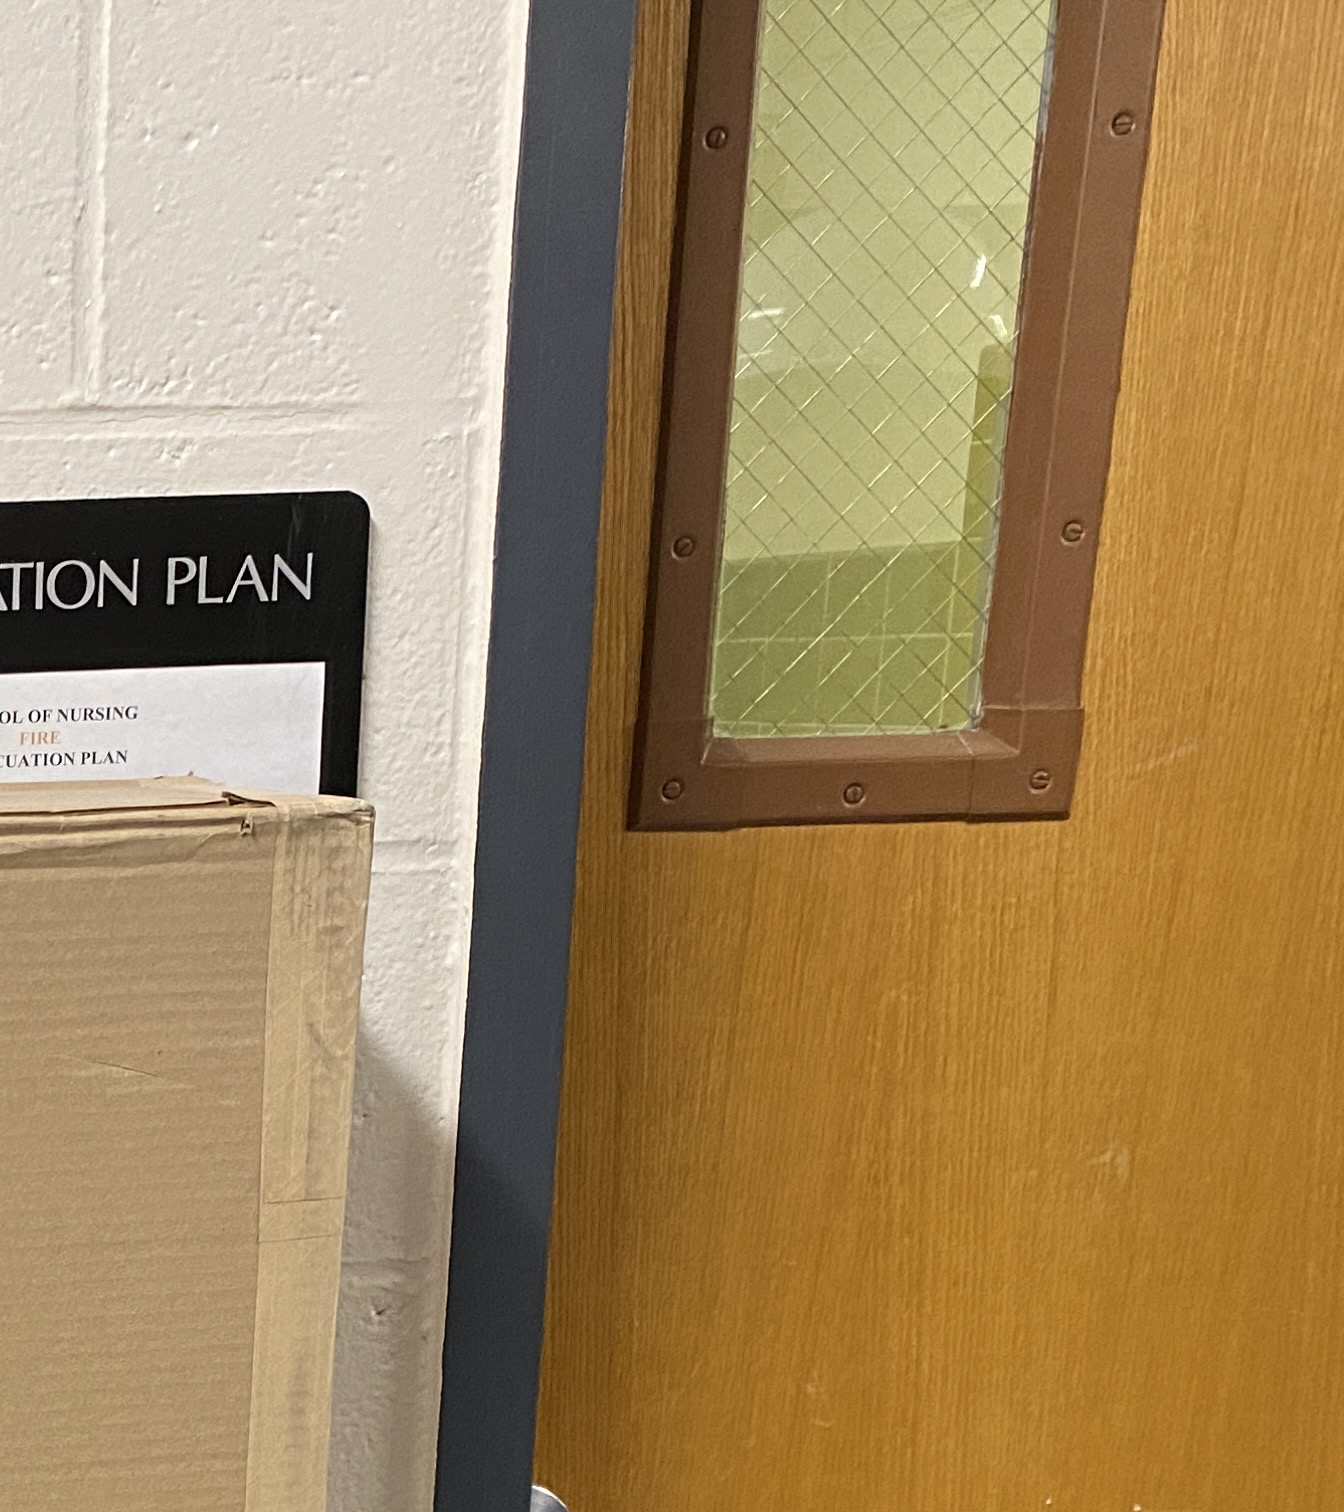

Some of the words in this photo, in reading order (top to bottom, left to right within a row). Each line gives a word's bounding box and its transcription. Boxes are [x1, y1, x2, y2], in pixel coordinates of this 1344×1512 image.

[166, 552, 315, 606] PLAN
[28, 708, 52, 723] OF
[56, 706, 139, 723] NURSING
[19, 730, 61, 746] FIRE
[80, 750, 128, 766] PLAN
